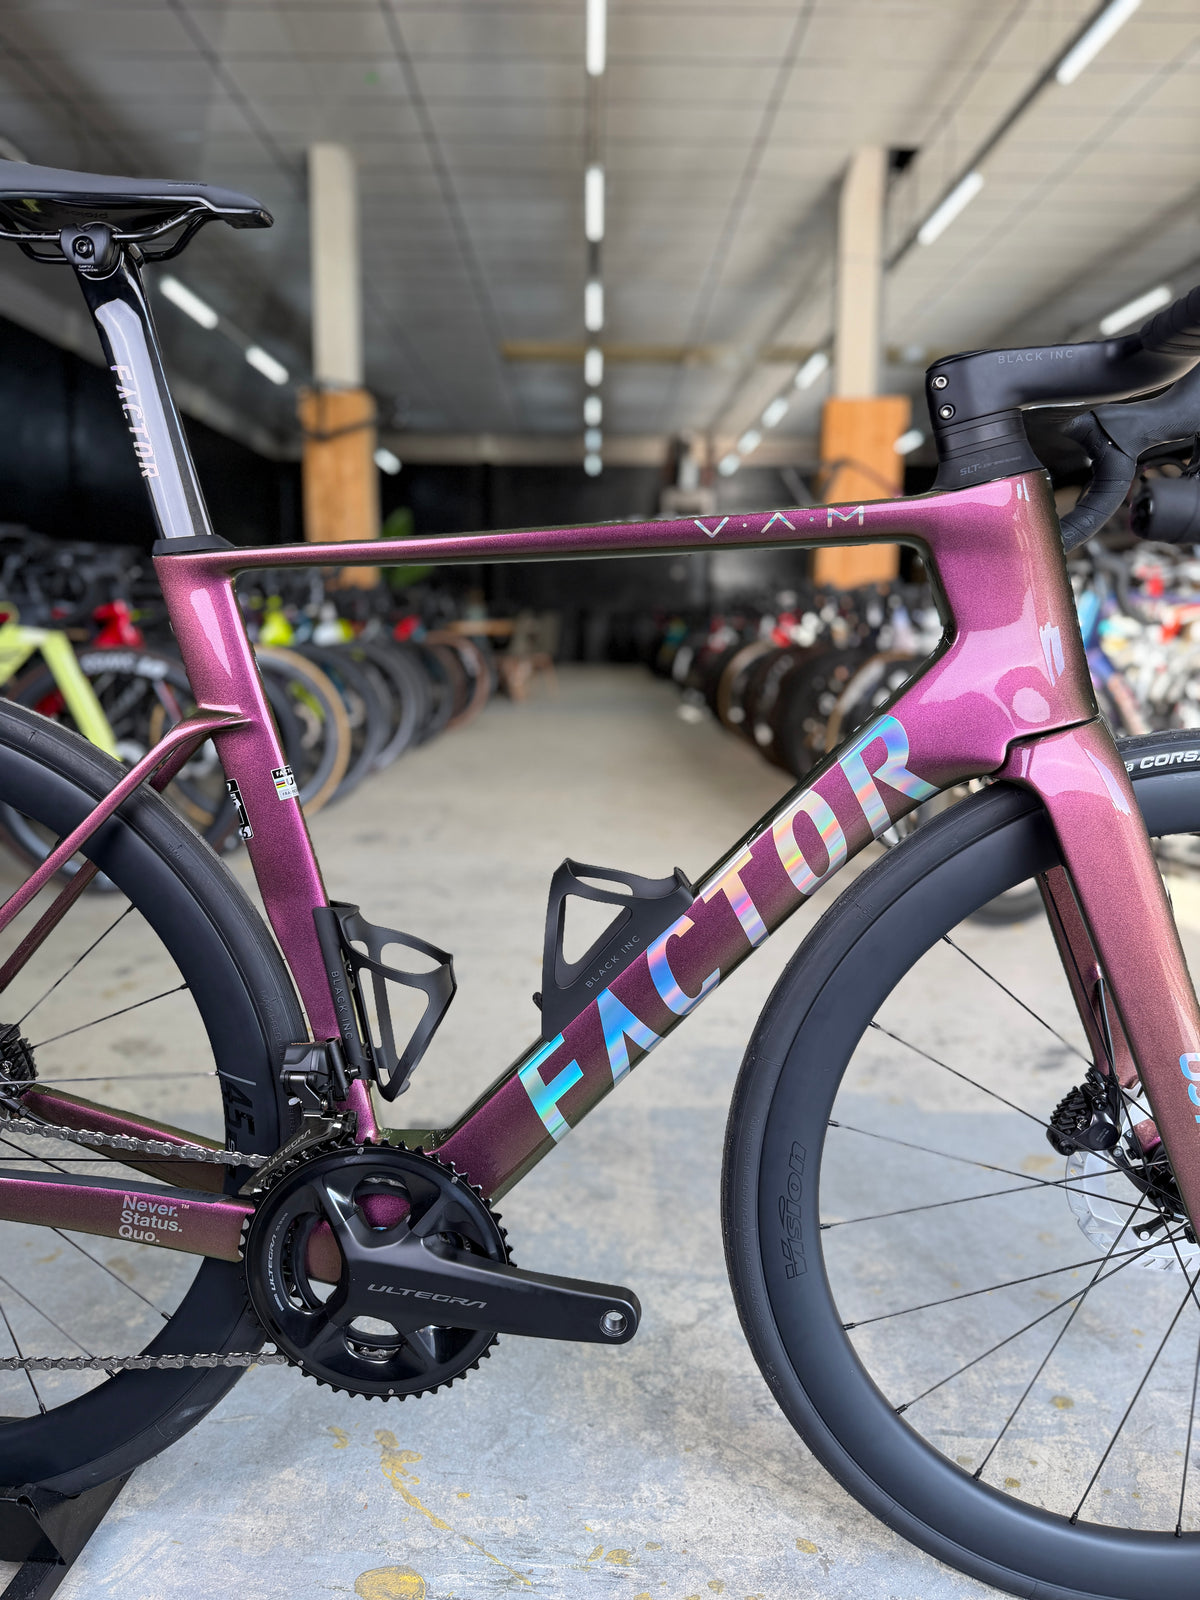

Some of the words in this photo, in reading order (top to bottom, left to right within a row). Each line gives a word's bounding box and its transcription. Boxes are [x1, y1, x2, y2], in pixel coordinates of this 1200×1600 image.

[997, 352, 1044, 365] BLACK
[1049, 349, 1075, 361] INC
[110, 365, 160, 478] FACTOR
[1140, 750, 1200, 769] CORS
[517, 714, 941, 1144] FACTOR
[584, 955, 620, 988] BLACK
[620, 935, 641, 954] INC
[330, 970, 349, 1014] BLACK
[341, 1018, 354, 1040] INC
[268, 1128, 312, 1167] ULTEGRA
[120, 1210, 183, 1233] Status.
[122, 1194, 179, 1217] Never.
[779, 1140, 808, 1280] Vision
[118, 1224, 160, 1243] Quo.
[367, 1283, 488, 1309] ULTEGRA
